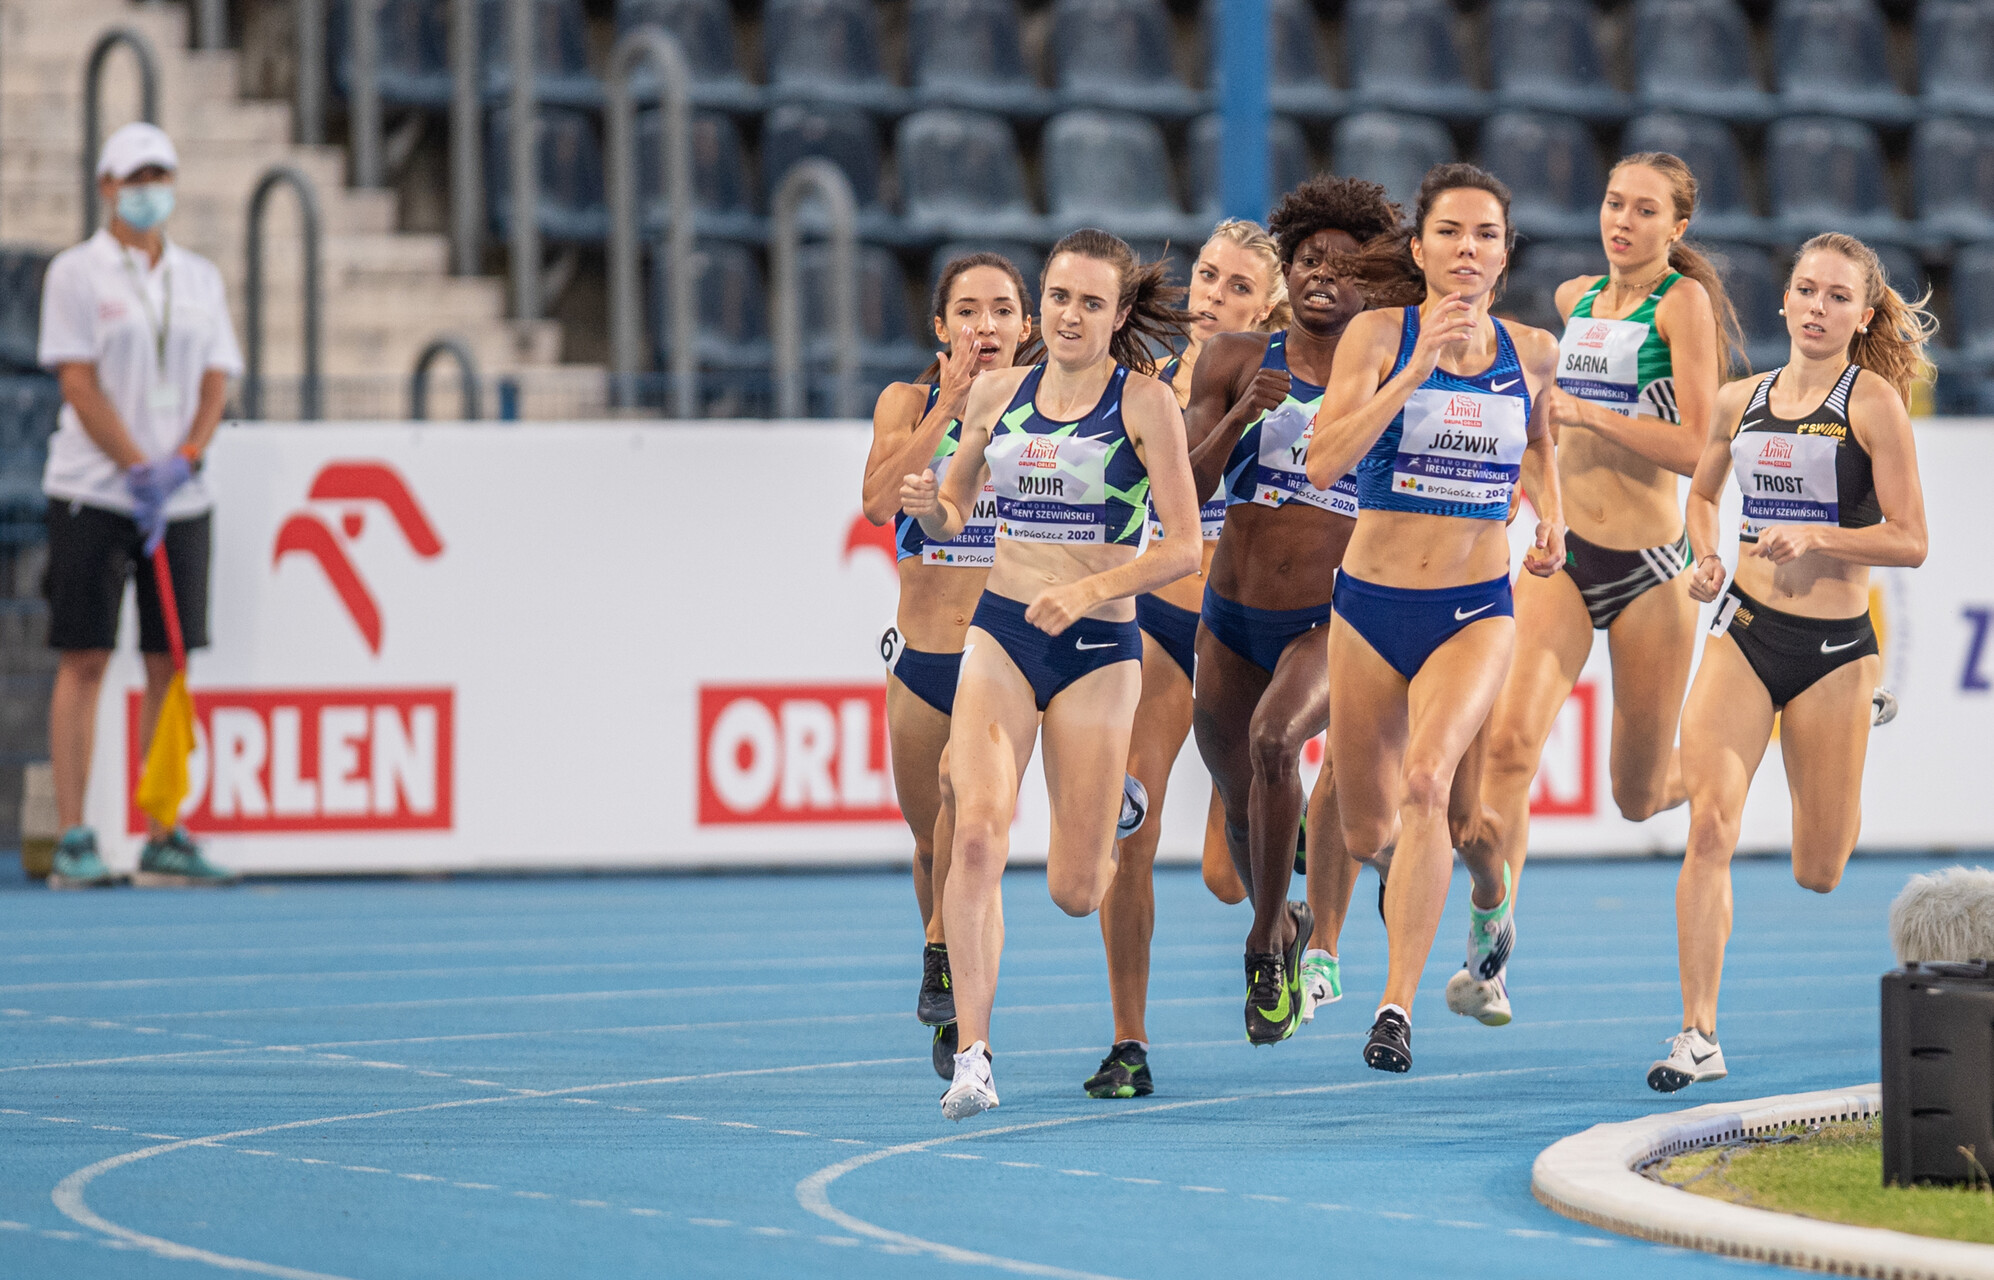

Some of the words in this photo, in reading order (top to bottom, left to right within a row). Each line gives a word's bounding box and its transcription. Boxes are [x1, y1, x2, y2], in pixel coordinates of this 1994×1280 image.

[1566, 353, 1608, 374] SARNA
[1580, 386, 1629, 401] SZEWIŃSKIEJ
[1444, 397, 1481, 418] Anwil
[1020, 440, 1059, 459] Anwil
[1428, 429, 1499, 456] JÓŹWIK
[1759, 439, 1793, 459] Anwil
[1425, 464, 1454, 476] IRENY
[1456, 467, 1510, 481] SZEWIŃSKIEJ
[1019, 476, 1063, 496] MUIR
[1287, 479, 1304, 489] IRE
[1428, 485, 1482, 499] BYDGOSZCZ
[1753, 473, 1803, 494] TROST
[1331, 498, 1355, 512] 2020
[1750, 506, 1775, 515] IRENY
[1776, 507, 1828, 520] SZEWIŃSKIEJ
[1011, 508, 1034, 518] IRENY
[1035, 510, 1095, 522] SZEWIŃSKIEJ
[953, 534, 981, 543] IRENY
[1014, 529, 1063, 540] BYDGOSZCZ
[1067, 530, 1095, 540] 2020
[957, 554, 994, 563] BYDGOS
[881, 627, 898, 662] 6
[707, 697, 891, 813] ORL
